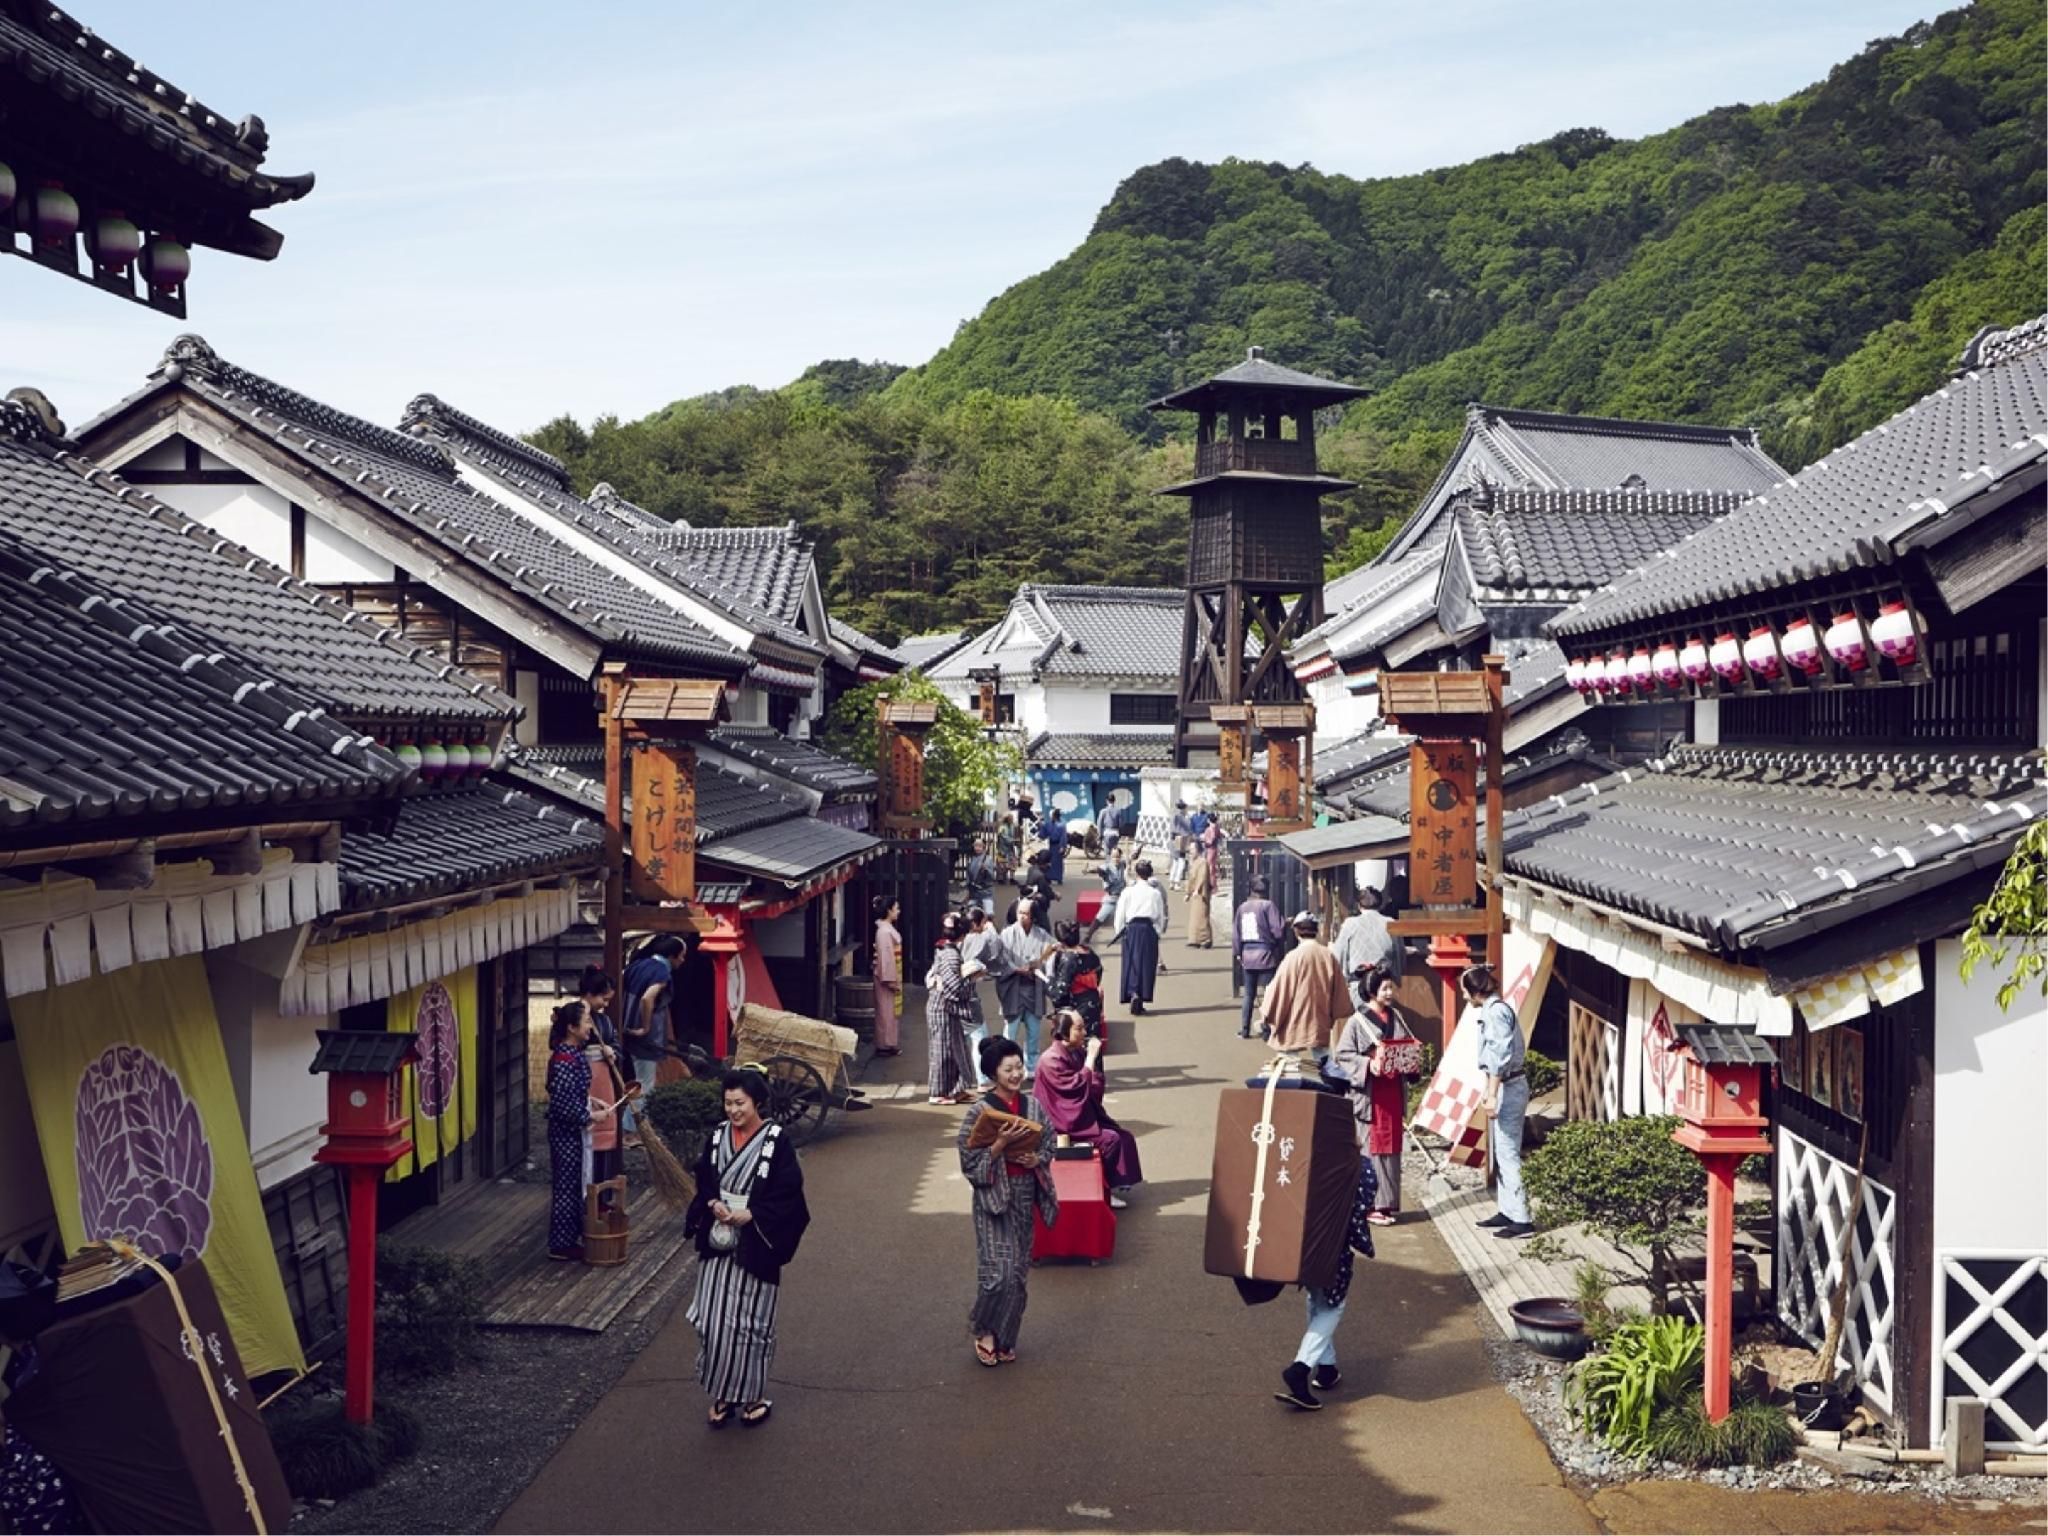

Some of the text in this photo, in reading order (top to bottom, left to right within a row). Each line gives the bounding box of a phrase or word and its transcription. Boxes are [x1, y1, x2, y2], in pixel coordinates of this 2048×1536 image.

[645, 778, 667, 881] こけし堂
[1431, 824, 1455, 896] 中者屋
